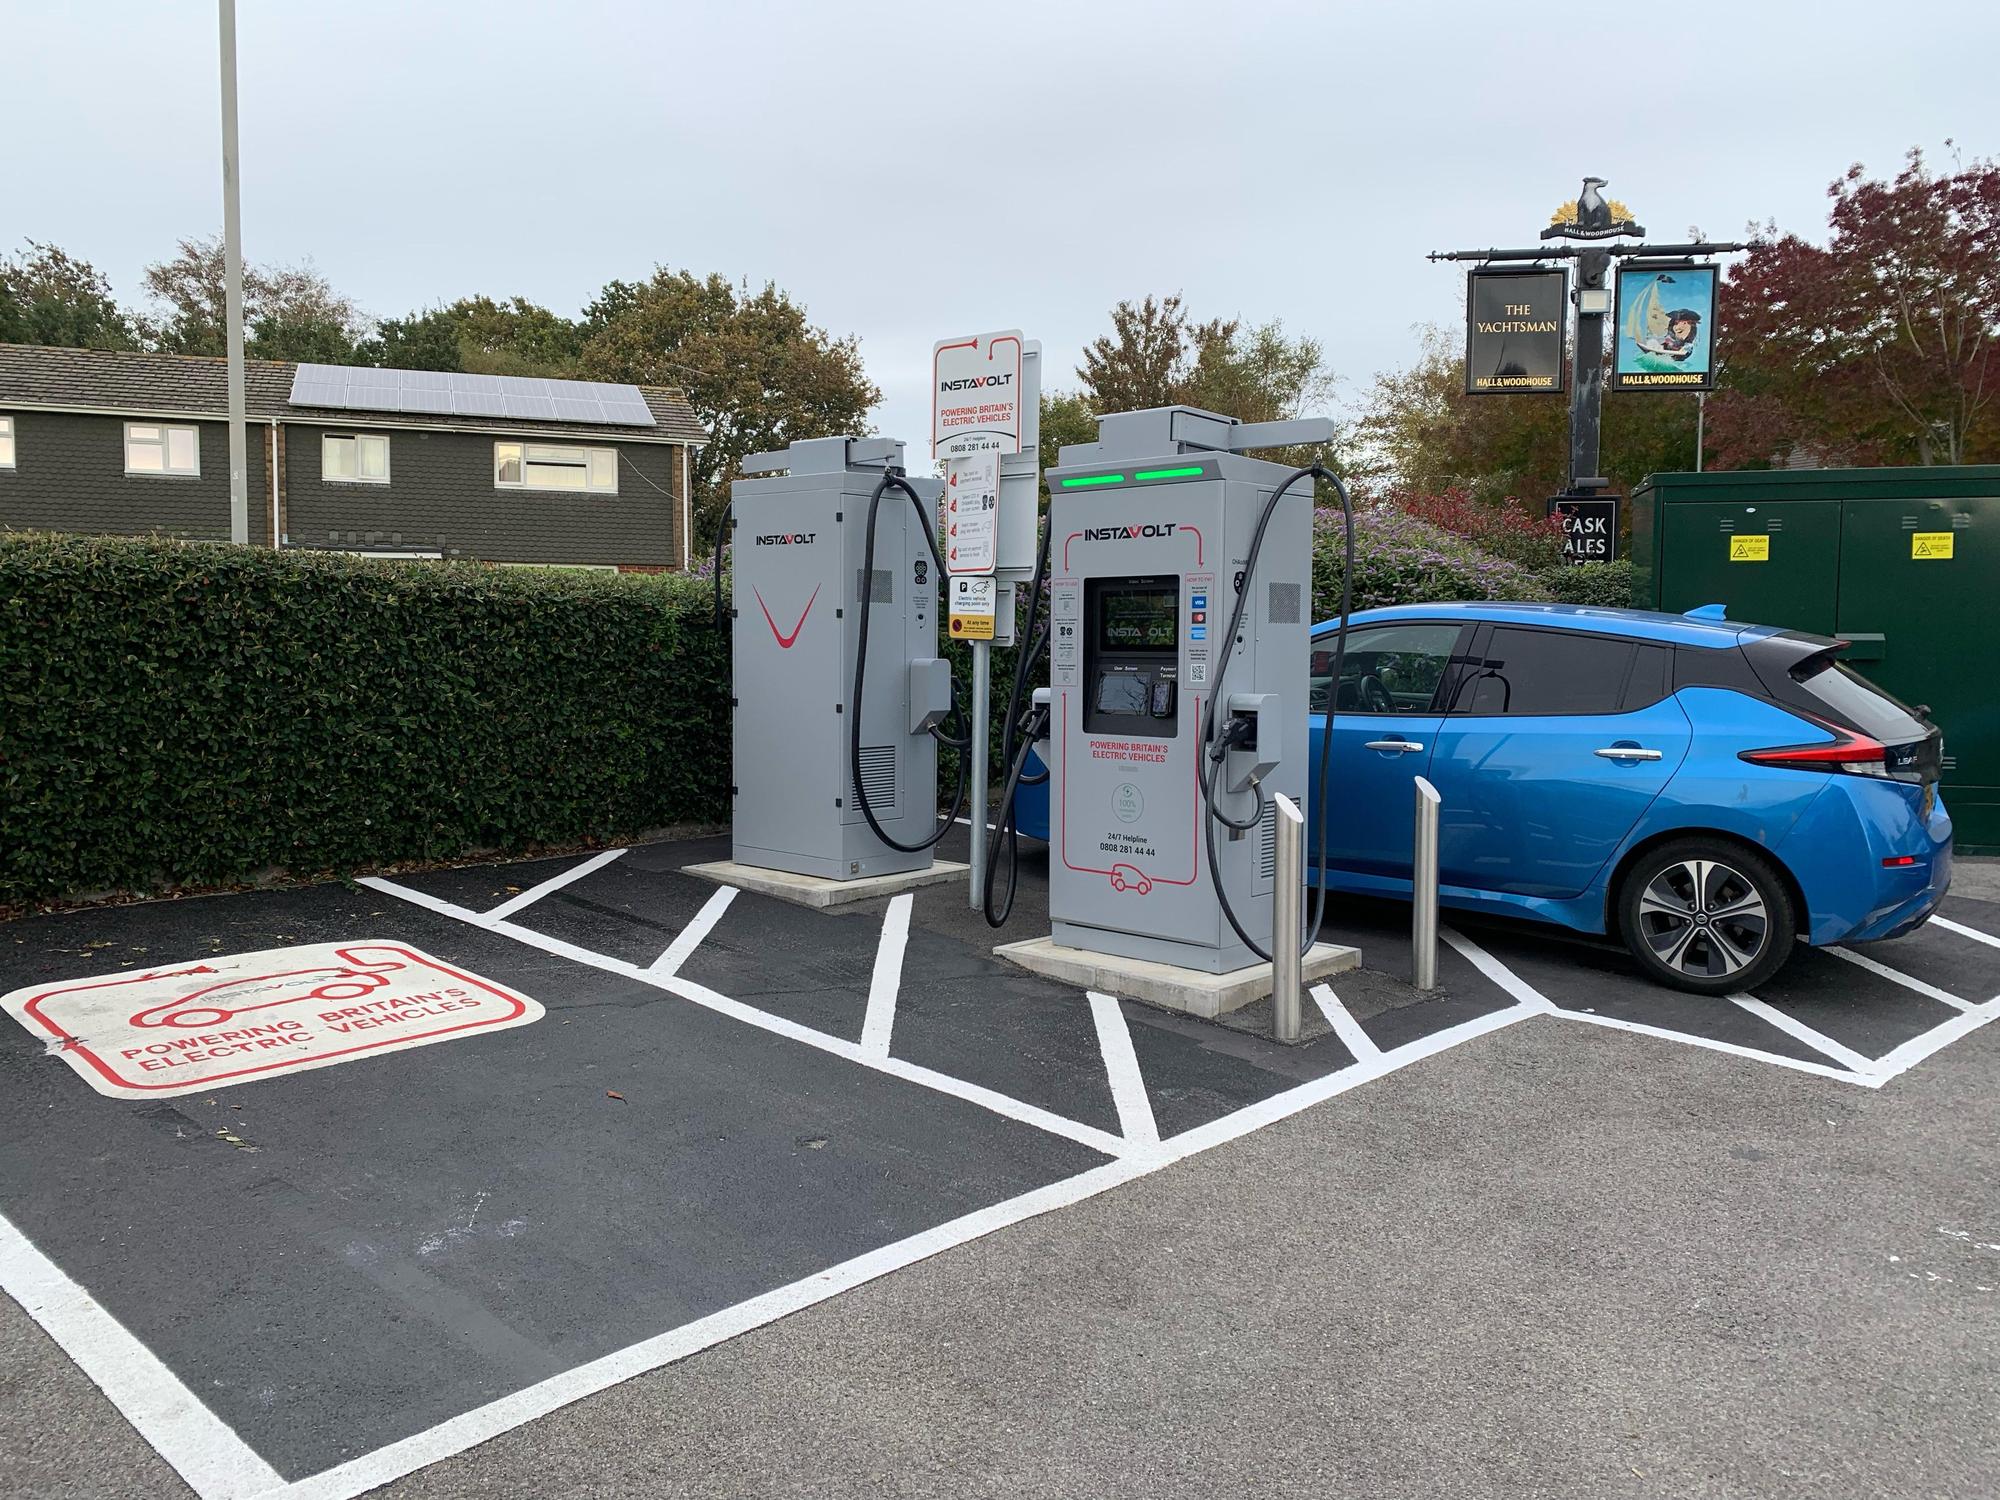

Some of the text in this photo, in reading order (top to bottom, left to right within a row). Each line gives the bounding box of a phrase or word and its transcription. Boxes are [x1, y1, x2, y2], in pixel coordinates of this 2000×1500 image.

[1505, 304, 1531, 316] THE
[1477, 321, 1557, 333] YACHTSMAN
[941, 374, 1013, 392] INSTAVOLT
[940, 402, 1014, 417] POWERING BRITAIN'S
[943, 412, 1011, 426] ELECTRIC VEHICLES
[950, 441, 1000, 452] 0808 281 44 44
[1084, 523, 1177, 541] INSTAVOLT
[1562, 517, 1607, 534] CASK
[756, 533, 816, 545] INSTAVOLT
[1563, 538, 1606, 554] ALES
[1107, 627, 1173, 637] INSTAOLT
[1090, 740, 1168, 754] POWERING BRITAIN'S
[1092, 750, 1165, 763] ELECTRIC VEHICLES
[1107, 832, 1148, 844] 24/7 Helpline
[1099, 842, 1155, 856] 0808 281 44 44
[119, 988, 467, 1060] POWERING BRITAIN'S
[138, 998, 481, 1072] ELECTRIC VEHICLES
